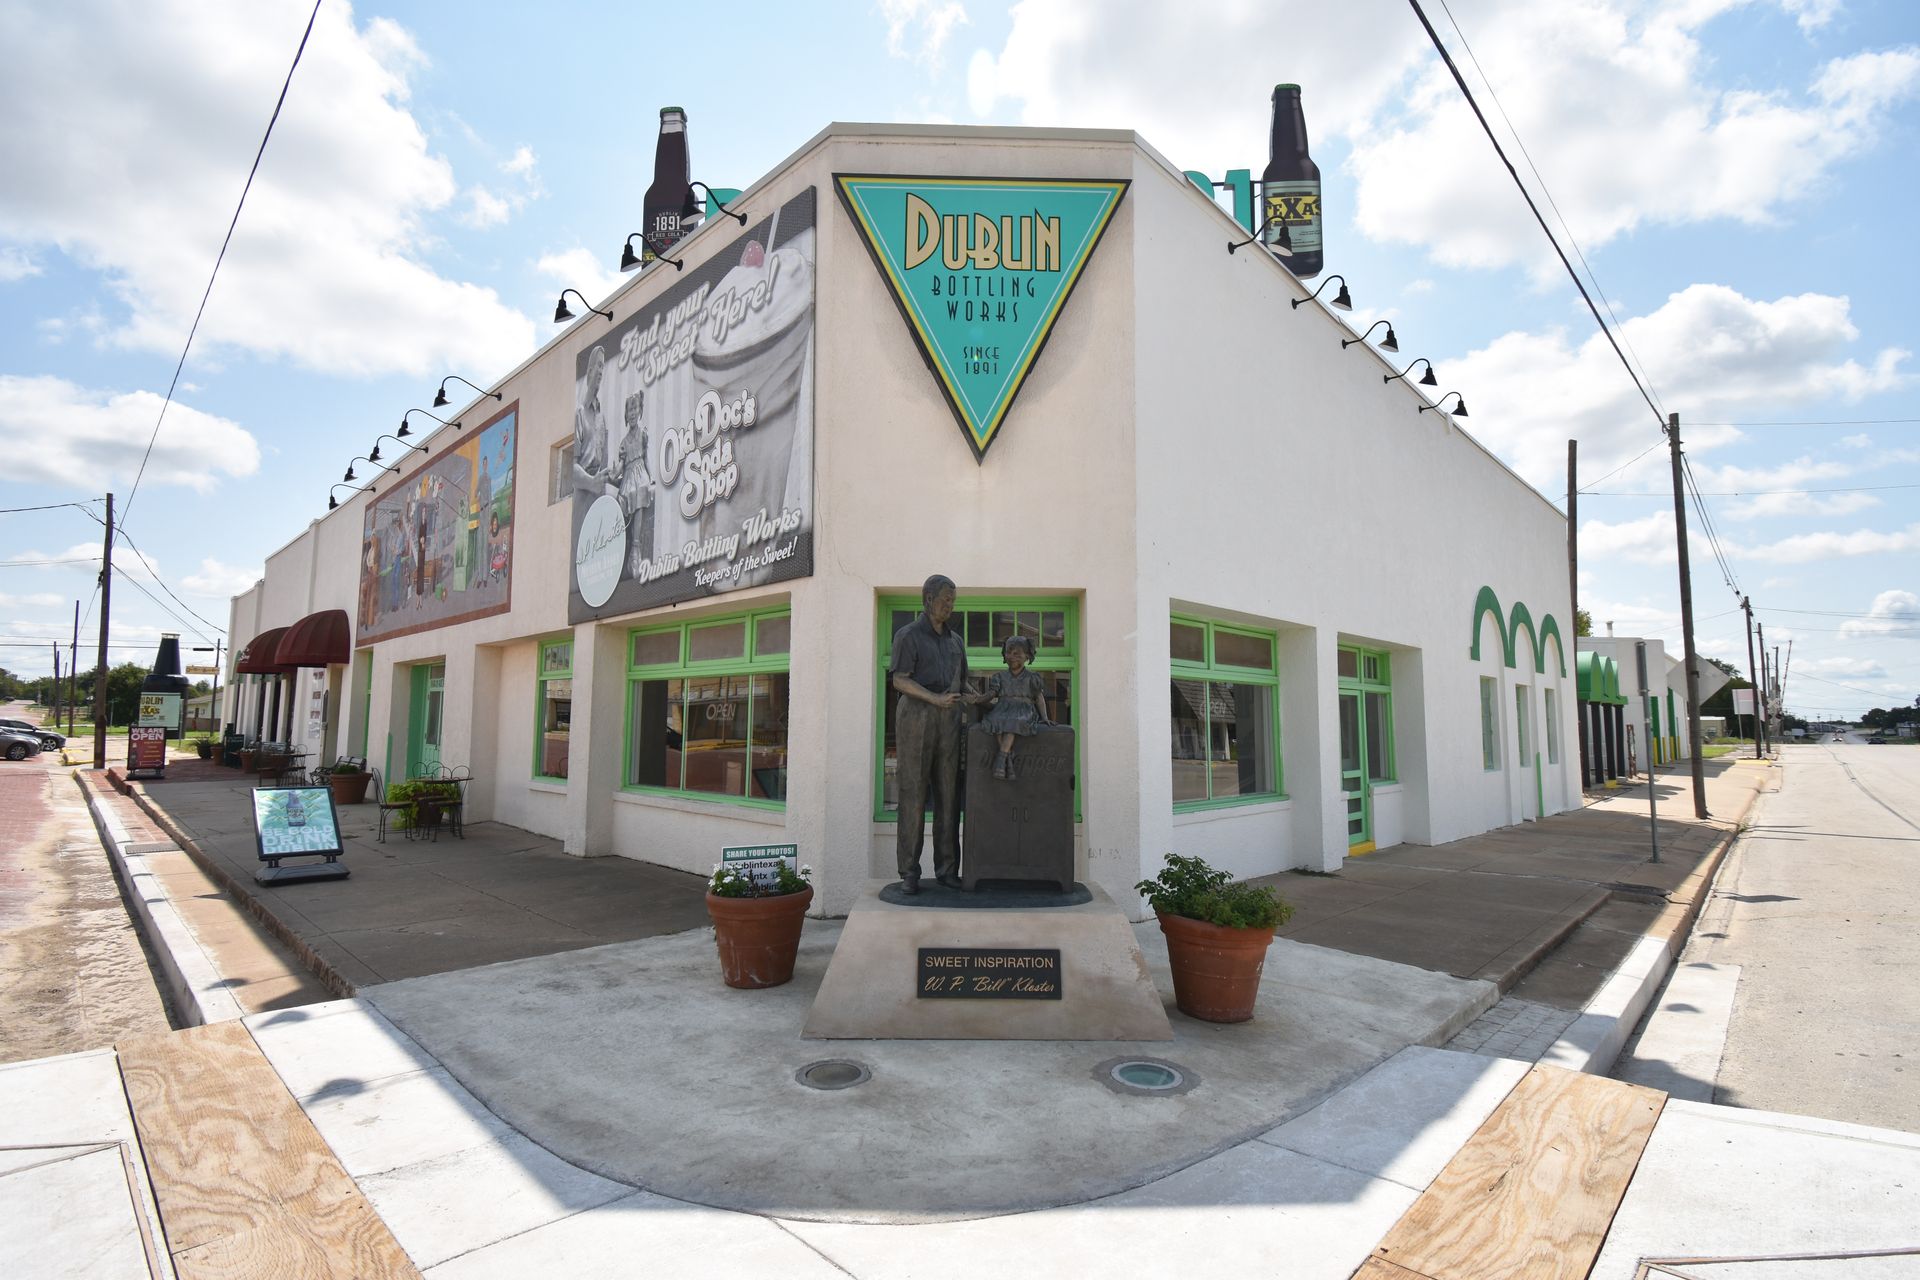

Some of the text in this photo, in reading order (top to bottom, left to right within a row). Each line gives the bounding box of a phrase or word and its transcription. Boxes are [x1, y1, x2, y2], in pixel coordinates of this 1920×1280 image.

[656, 215, 680, 231] 1891
[904, 192, 1061, 272] DUBLIN
[931, 275, 1035, 298] BOTTLING
[711, 254, 780, 345] Here!
[946, 301, 1018, 322] WORKS
[618, 281, 711, 371] Find your
[963, 346, 999, 359] SINCE
[965, 361, 997, 375] 1891
[659, 388, 757, 487] Old Doc's
[638, 552, 680, 584] Dublin
[683, 533, 740, 568] Bottling
[742, 507, 801, 545] Works
[695, 535, 798, 587] Keepers of the Sweet!
[706, 703, 736, 720] OPEN
[1012, 752, 1066, 776] epper
[262, 825, 332, 837] BE BOLD
[262, 832, 333, 847] DRINK
[263, 842, 338, 854] DUBLIN
[726, 847, 794, 858] SHARE YOUR PHOTOS!
[925, 956, 1053, 968] SWEET INSPIRATION
[925, 976, 1054, 992] W. P. "Bill" Kloster
